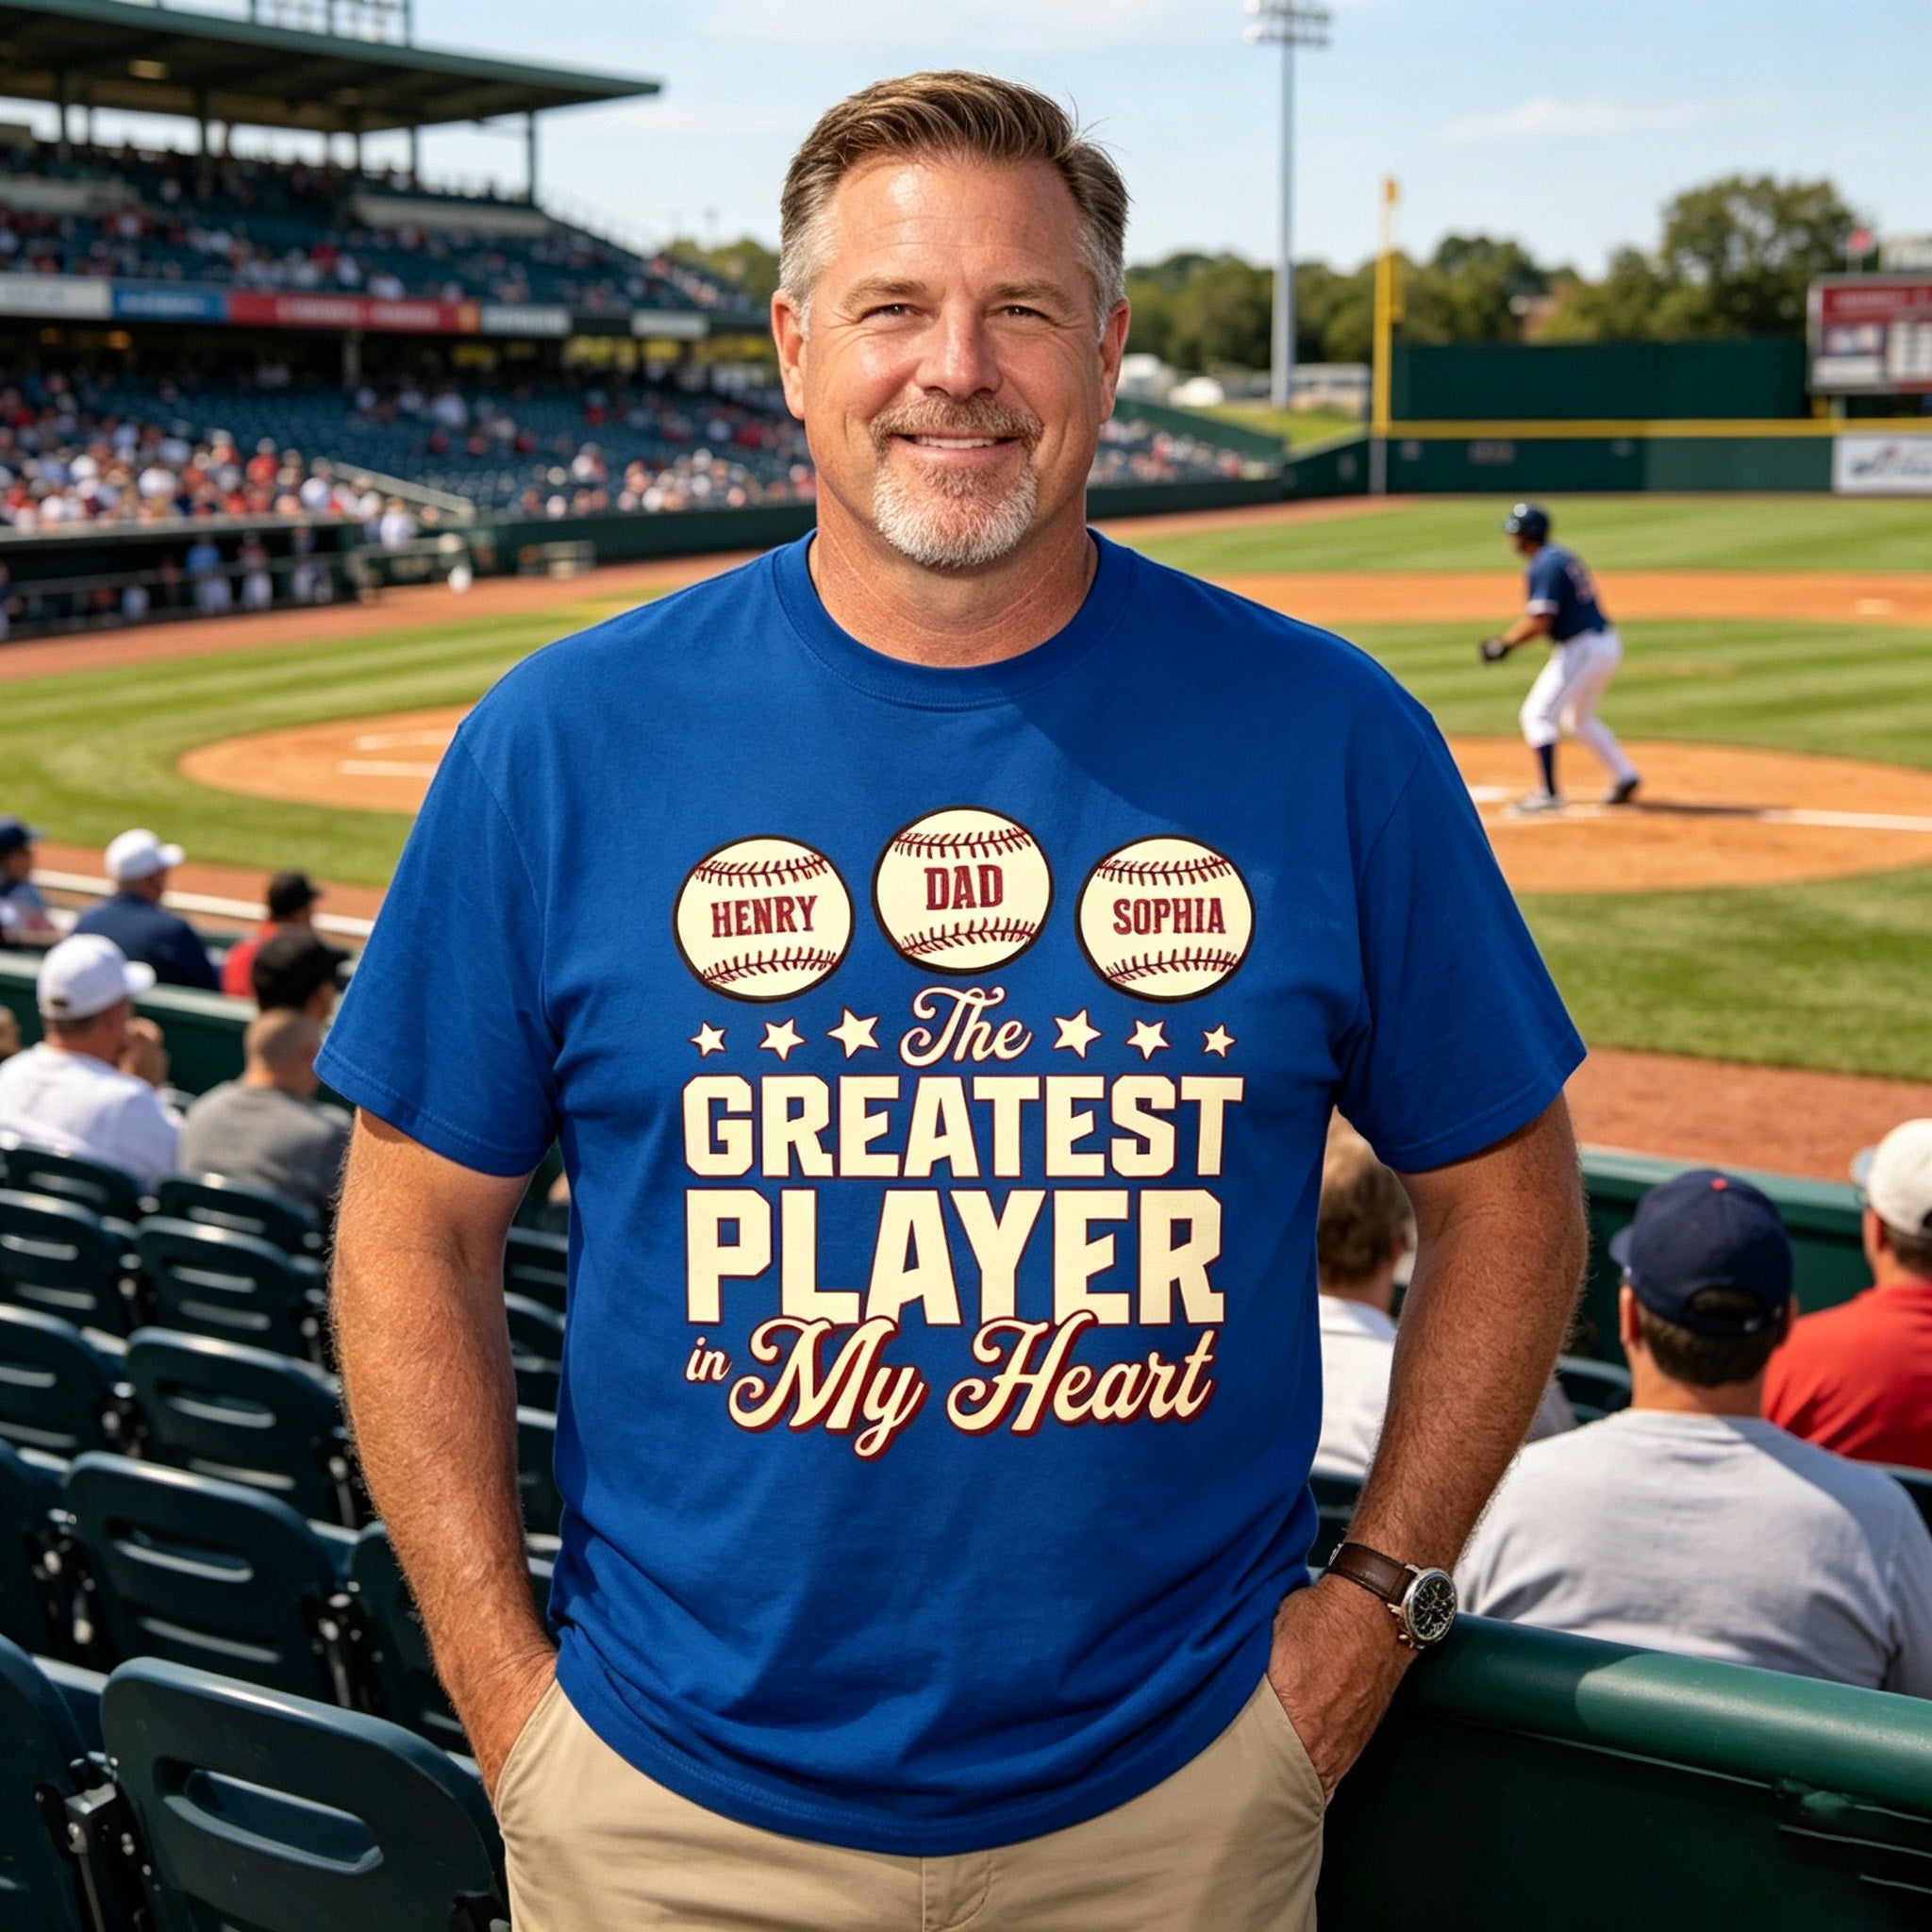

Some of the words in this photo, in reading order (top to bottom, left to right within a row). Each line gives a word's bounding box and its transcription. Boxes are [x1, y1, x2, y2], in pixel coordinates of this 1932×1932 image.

[710, 894, 819, 939] HENRY
[924, 864, 1004, 911] DAD
[1112, 897, 1227, 936] SOPHIA
[899, 985, 1033, 1067] The
[681, 1074, 1245, 1178] GREATEST
[685, 1188, 1225, 1324] PLAYER
[685, 1336, 732, 1383] in
[727, 1315, 930, 1461] My
[946, 1309, 1219, 1436] Heart
